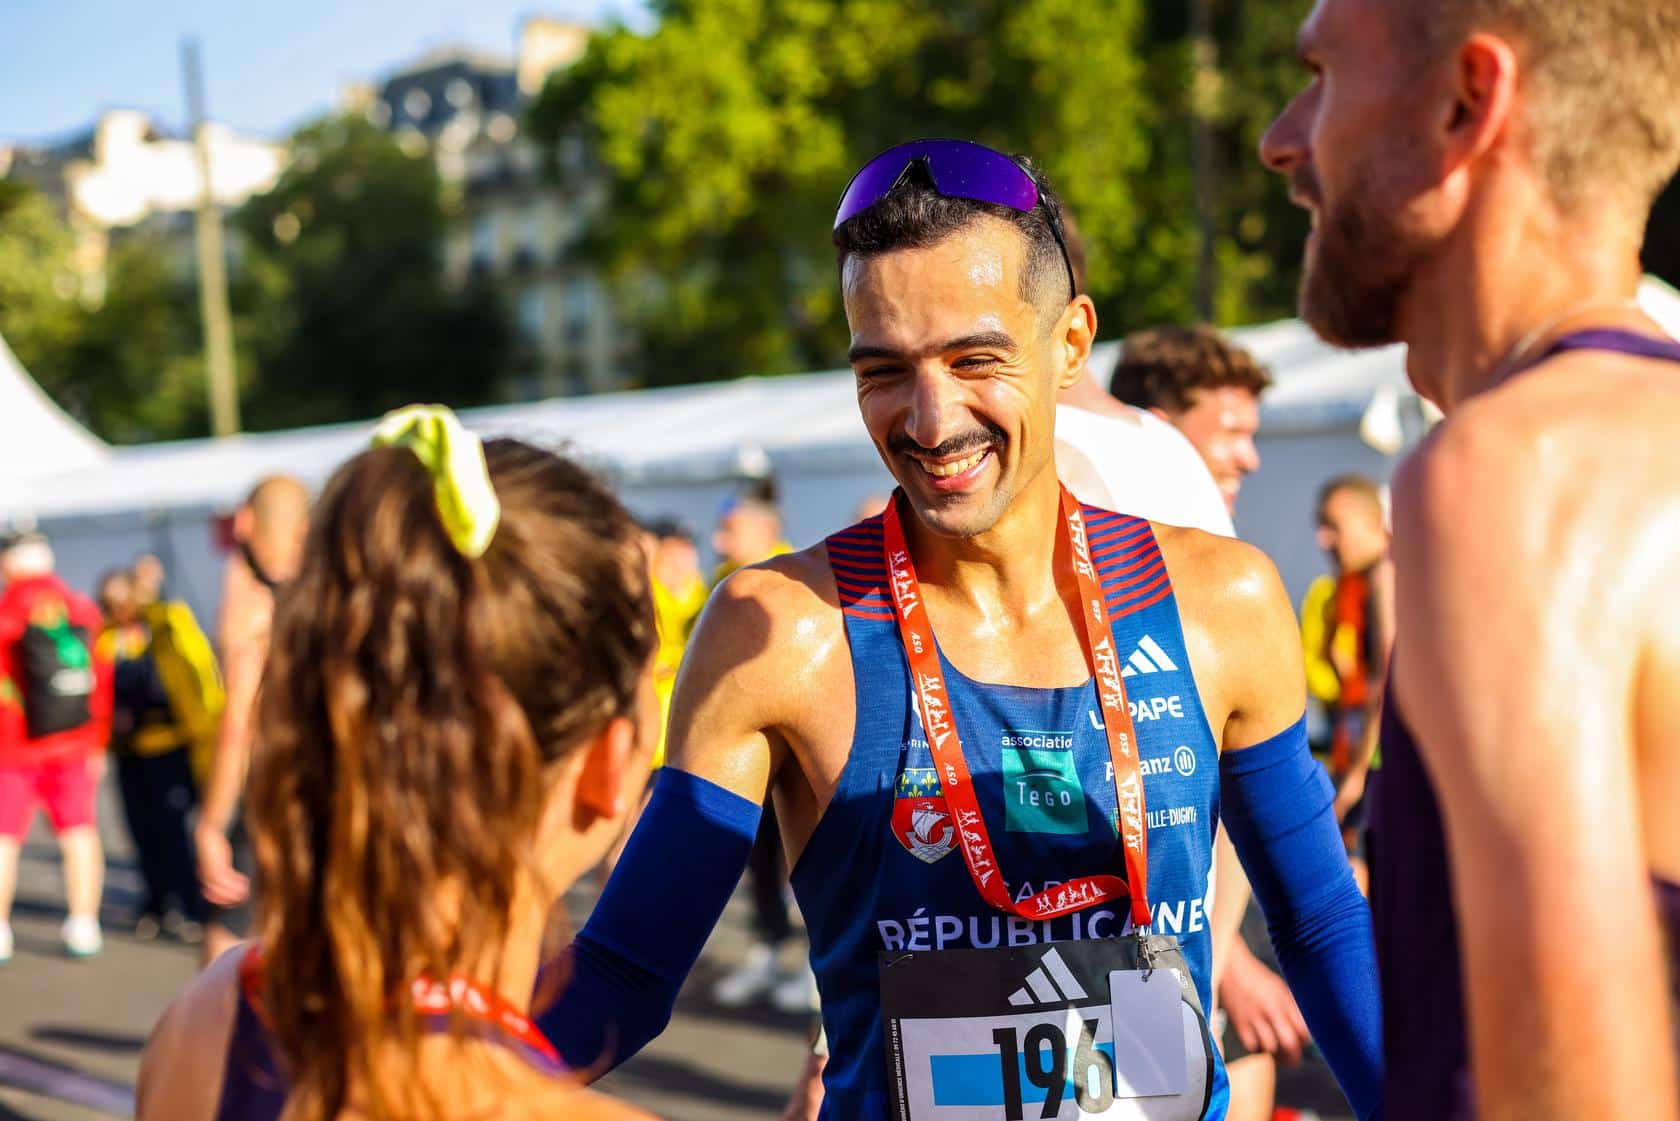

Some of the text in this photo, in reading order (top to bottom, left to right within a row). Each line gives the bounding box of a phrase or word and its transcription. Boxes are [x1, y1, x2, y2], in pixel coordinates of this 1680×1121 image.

[911, 632, 923, 654] ASO
[1088, 695, 1184, 731] LPAPE
[992, 1018, 1116, 1121] 196
